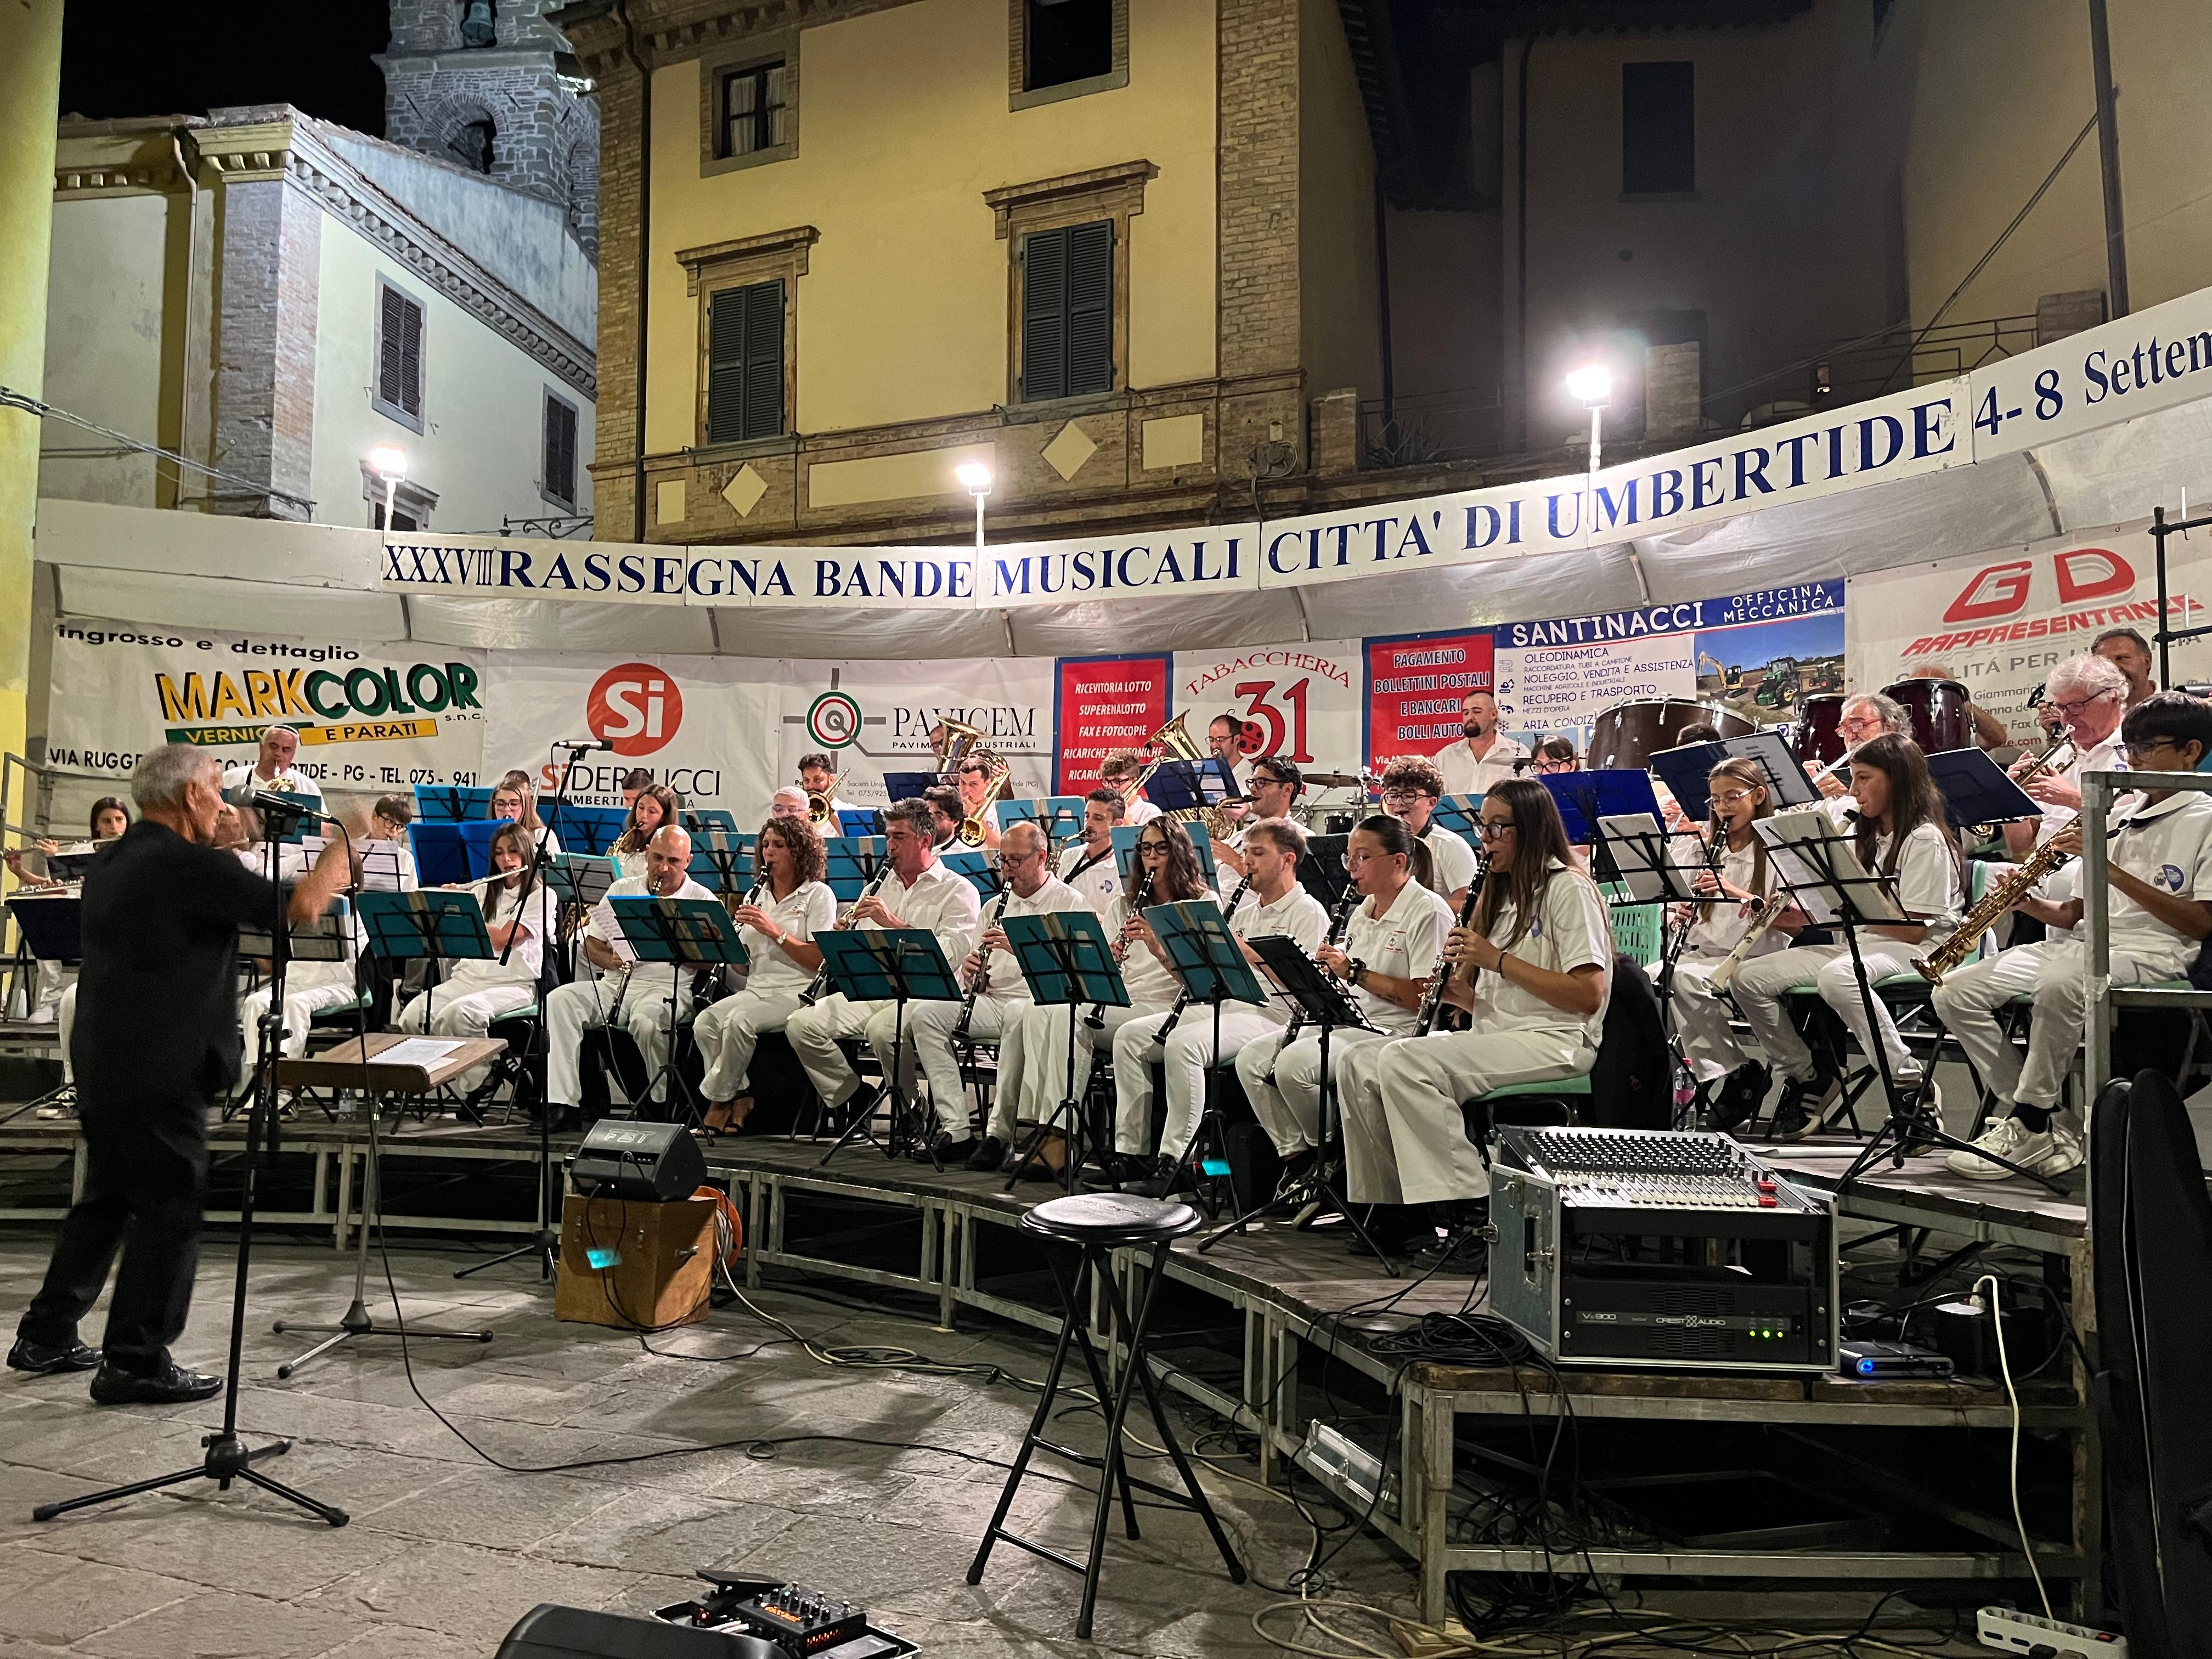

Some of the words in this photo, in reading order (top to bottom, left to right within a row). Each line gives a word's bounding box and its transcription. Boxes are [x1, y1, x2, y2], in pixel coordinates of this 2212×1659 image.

[384, 545, 493, 586] XXXVIII
[495, 550, 795, 596] RASSEGNA
[812, 560, 972, 598] BANDE
[992, 539, 1243, 596] MUSICALI
[1268, 511, 1441, 573] CITTA'
[1462, 500, 1526, 550] DI
[1543, 398, 1955, 539] UMBERTIDE
[1732, 584, 1824, 607] OFFICINA
[1724, 595, 1833, 622] MECCANICA
[1513, 602, 1703, 647] SANTINACCI
[1900, 594, 2204, 657] RAPPRESENTANZE
[59, 625, 183, 647] ingrosso
[196, 640, 213, 650] e
[231, 640, 359, 662] dettaglio
[1394, 649, 1465, 668] PAGAMENTO
[1524, 663, 1575, 673] RACCORDATURA
[1601, 656, 1633, 666] CAMPIONE
[1525, 648, 1609, 663] OLEODINAMICA
[2010, 652, 2058, 671] PER
[1186, 652, 1349, 696] TABACCHERIA
[1583, 667, 1620, 679] VENDITA
[1624, 665, 1629, 674] E
[1634, 659, 1694, 673] ASSISTENZA
[1075, 682, 1122, 693] RICEVITORIA
[1125, 681, 1152, 692] LOTTO
[1375, 676, 1437, 693] BOLLETTINI
[1441, 672, 1489, 689] POSTALI
[1592, 676, 1625, 687] INDUSTRIALI
[154, 662, 483, 722] MARKCOLOR
[1523, 691, 1577, 705] RECUPERO
[1581, 691, 1585, 700] E
[1590, 684, 1656, 699] TRASPORTO
[603, 680, 664, 738] Si
[1079, 703, 1146, 715] SUPERENALOTTO
[1401, 702, 1408, 716] E
[1410, 698, 1462, 715] BANCARI
[1544, 705, 1570, 713] D'OPERA
[1235, 678, 1314, 764] 31
[1523, 719, 1549, 730] ARIA
[1554, 714, 1594, 727] CONDIZ
[2011, 720, 2031, 730] Fax
[185, 727, 267, 743] VERNIC
[326, 729, 337, 740] E
[345, 723, 417, 738] PARATI
[1079, 726, 1095, 737] FAX
[1096, 727, 1101, 736] E
[1102, 725, 1147, 736] FOTOCOPIE
[1398, 725, 1430, 740] BOLLI
[1432, 724, 1464, 738] AUTO
[50, 748, 78, 765] VIA
[1063, 747, 1107, 759] RICARICHE
[1375, 756, 1389, 764] Via
[344, 765, 364, 781] PG
[381, 767, 404, 784] TEL.
[410, 769, 434, 785] 075
[453, 771, 480, 787] 941
[1068, 770, 1103, 781] RICARIC
[565, 795, 623, 806] UMBERTI
[604, 1128, 656, 1144] FBT
